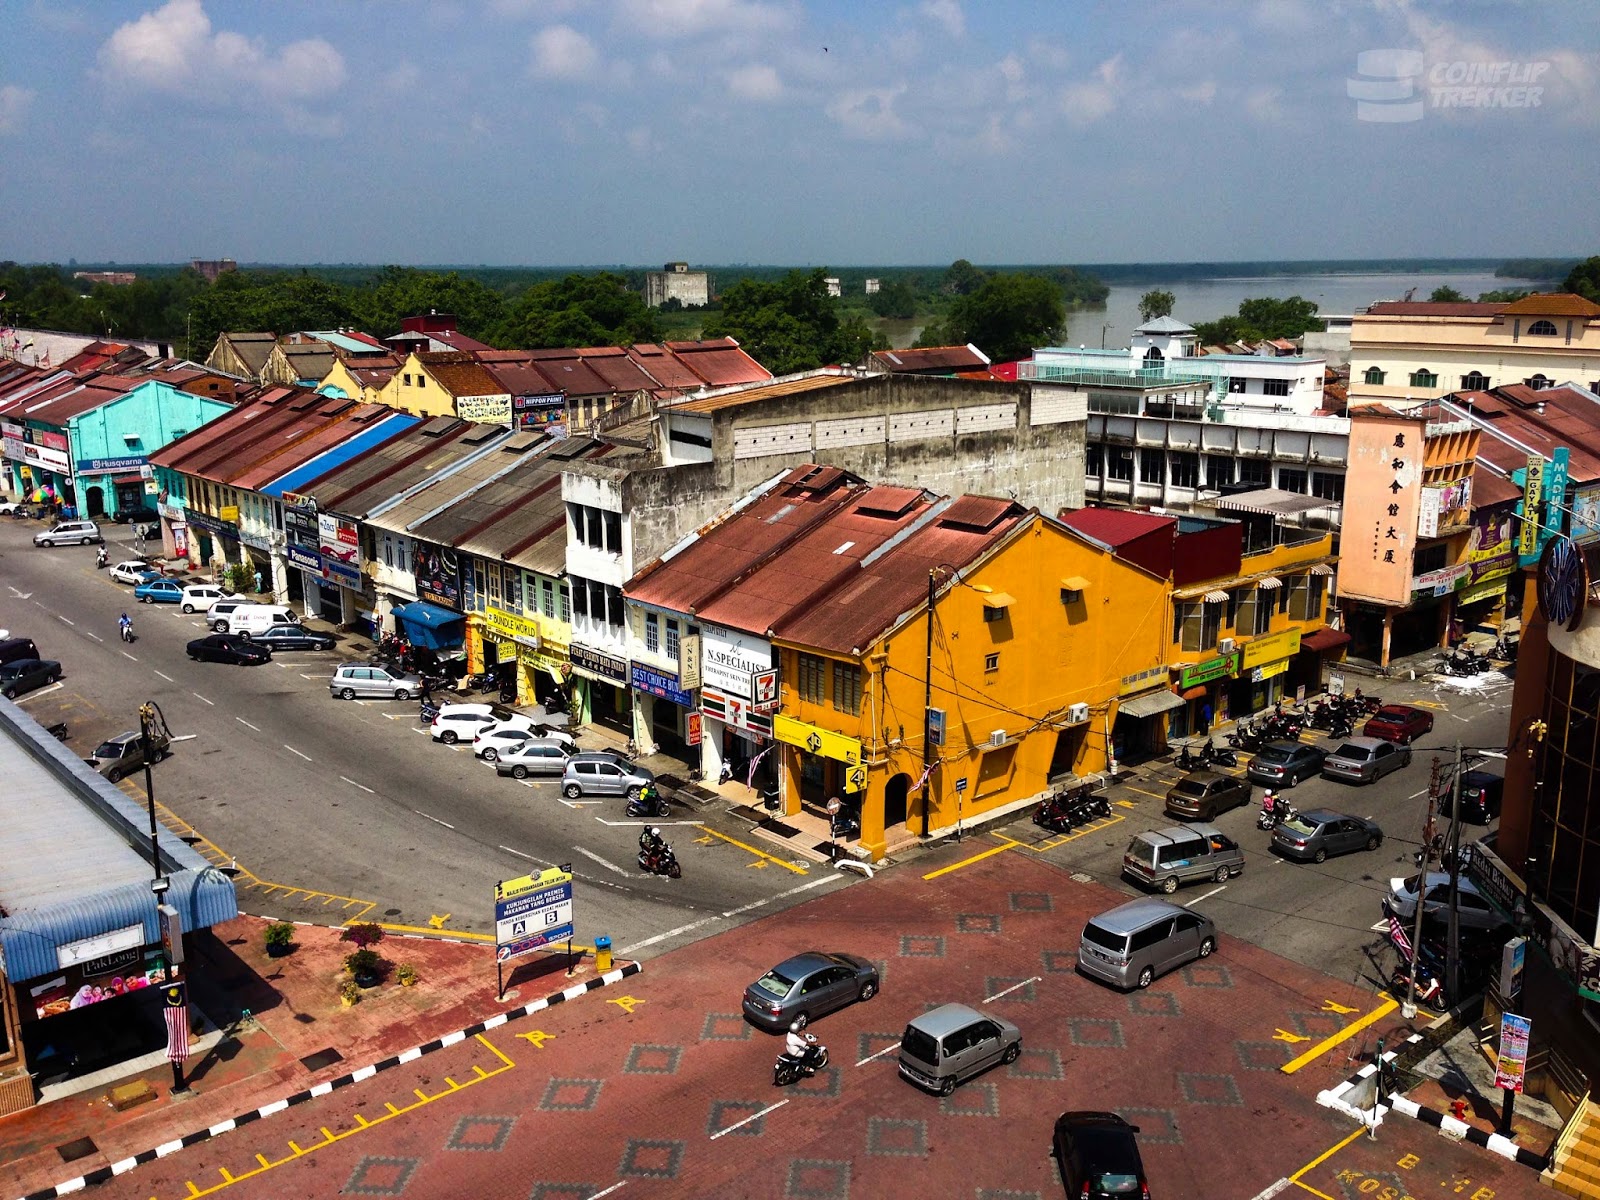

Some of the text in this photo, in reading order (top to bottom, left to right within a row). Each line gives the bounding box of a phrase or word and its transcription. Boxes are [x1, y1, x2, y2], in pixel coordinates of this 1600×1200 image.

[547, 396, 562, 404] PAINT
[101, 459, 142, 469] Husqvarna
[291, 549, 319, 568] Panasonic
[493, 613, 514, 630] BUNDLE
[515, 622, 536, 638] WORLD
[632, 667, 647, 684] BEST
[647, 670, 667, 689] CHOICE
[503, 893, 565, 917] MAKANAN YANG BERSIH
[506, 887, 564, 910] KUNJUNGILAH PREMIS
[500, 918, 514, 927] TANDA
[555, 901, 569, 909] MAKAN
